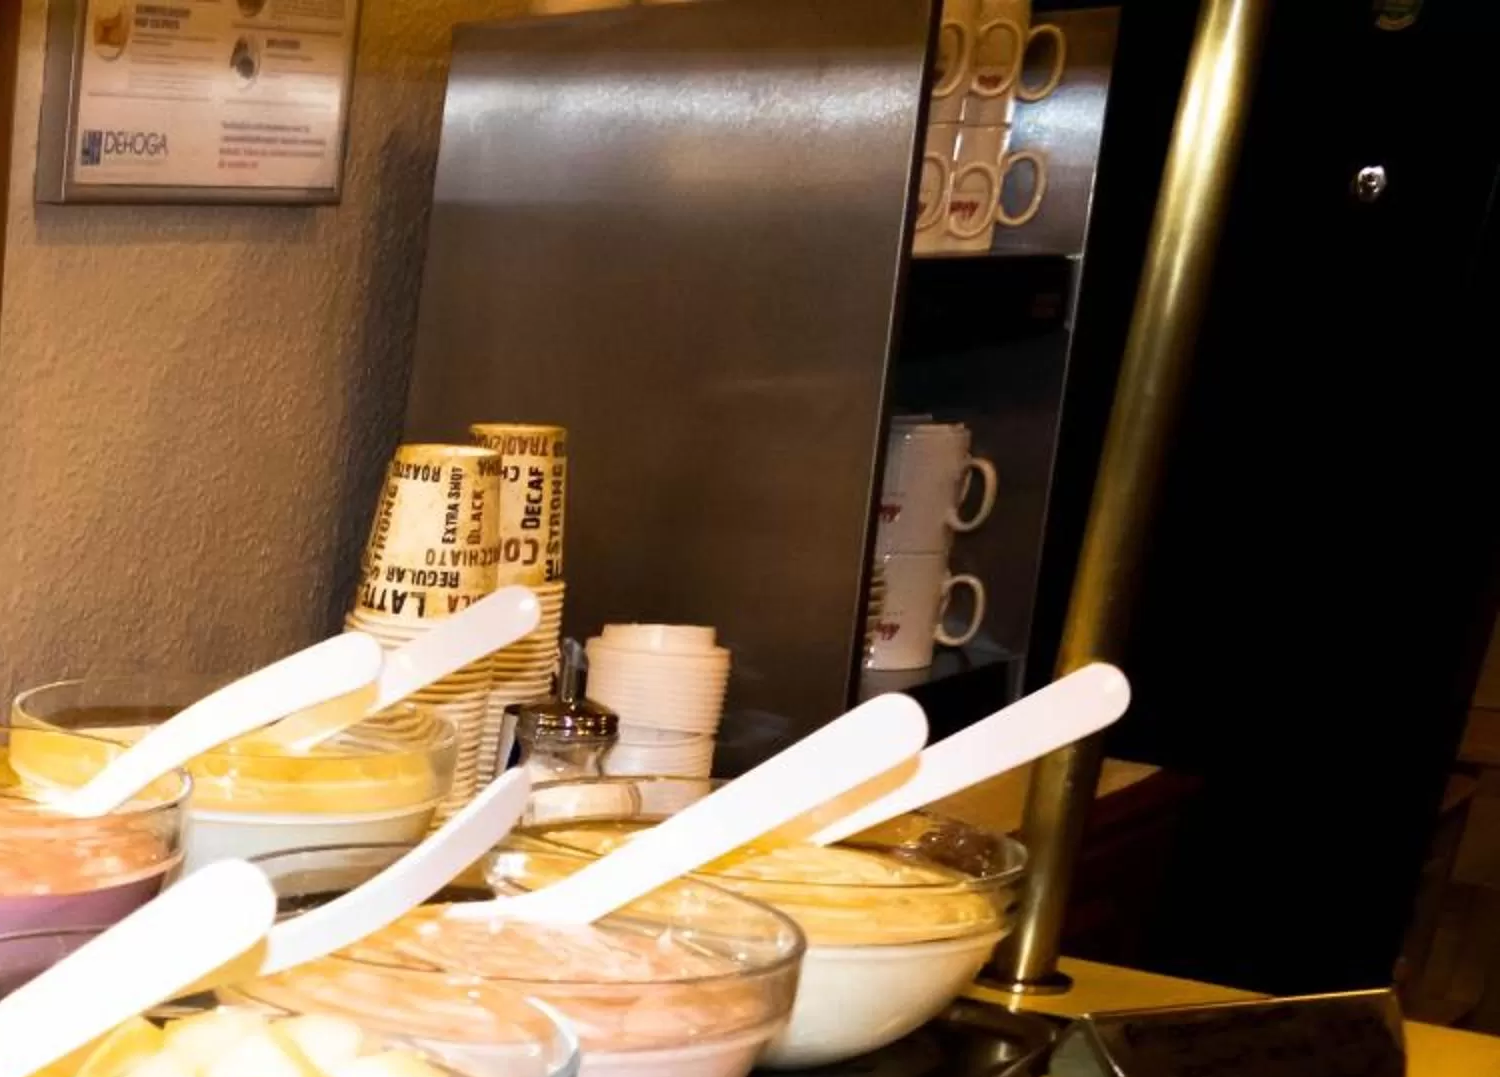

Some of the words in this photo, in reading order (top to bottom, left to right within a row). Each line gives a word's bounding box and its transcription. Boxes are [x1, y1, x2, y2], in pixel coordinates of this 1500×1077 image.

[104, 131, 169, 157] DEHOGA
[447, 467, 464, 500] SHOT
[521, 466, 545, 531] DECAF
[442, 502, 460, 545] EXTRA
[466, 489, 485, 546] BLACK
[545, 464, 565, 554] STRONG
[385, 566, 460, 589] REGULAR
[361, 584, 427, 618] LATTE
